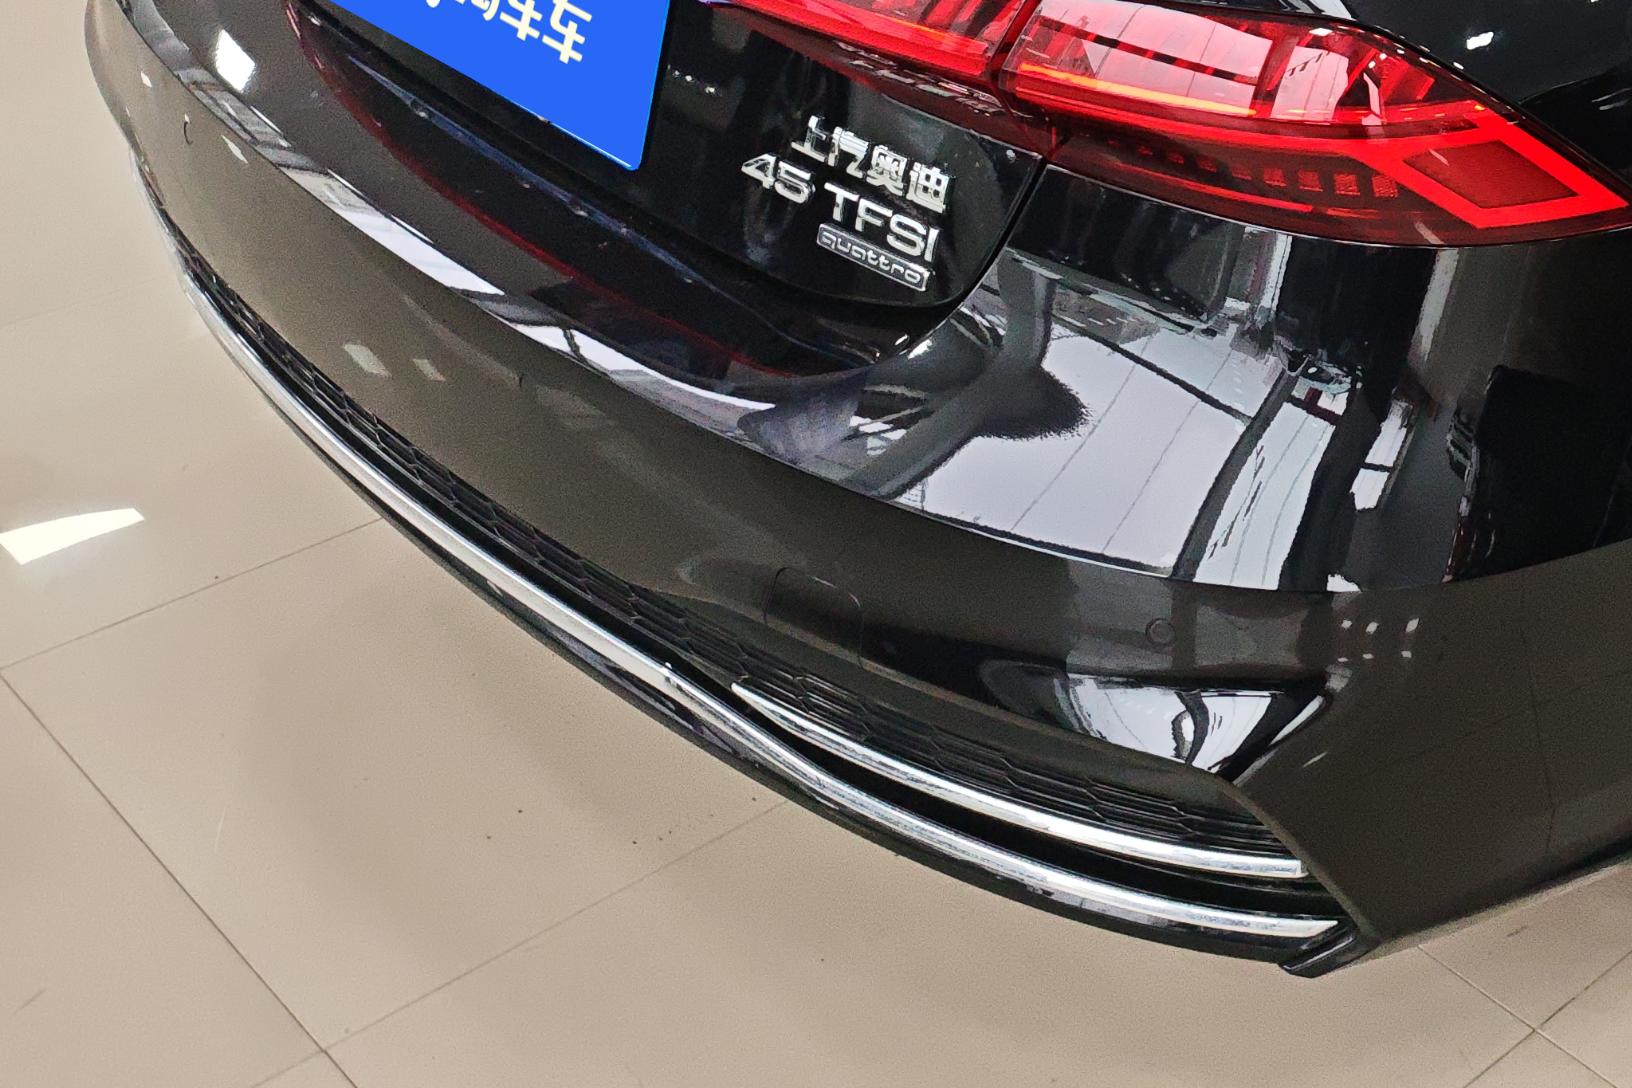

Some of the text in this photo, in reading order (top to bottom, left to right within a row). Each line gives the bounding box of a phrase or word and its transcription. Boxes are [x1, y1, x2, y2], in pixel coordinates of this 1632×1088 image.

[741, 153, 940, 262] 45 TFSI
[791, 115, 952, 213] 上汽奥迪
[820, 230, 922, 285] quattro
